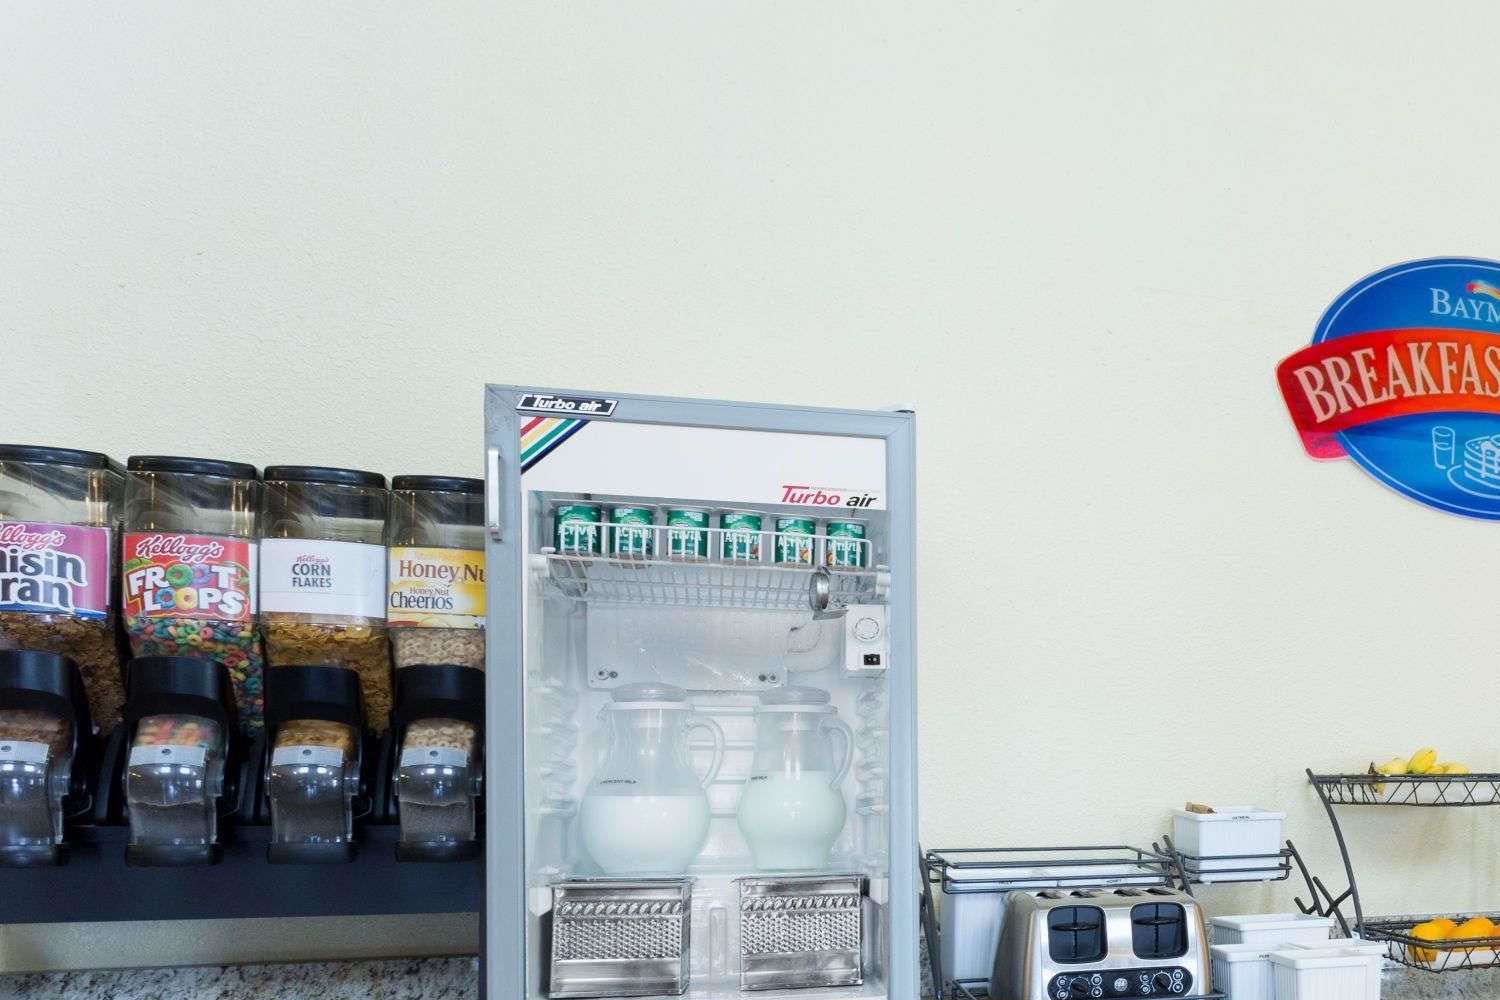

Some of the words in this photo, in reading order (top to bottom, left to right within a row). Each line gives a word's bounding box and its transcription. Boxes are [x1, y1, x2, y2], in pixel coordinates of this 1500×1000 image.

[533, 394, 575, 410] Turbo
[579, 401, 602, 412] air
[782, 485, 840, 506] Turbo
[846, 493, 877, 508] air
[136, 535, 224, 562] Kellogg's
[128, 564, 236, 596] FROOT
[292, 563, 331, 576] CORN
[400, 559, 460, 583] Honey
[292, 577, 331, 588] FLAKES
[143, 587, 246, 615] LOOPS
[390, 591, 454, 610] Cheerios
